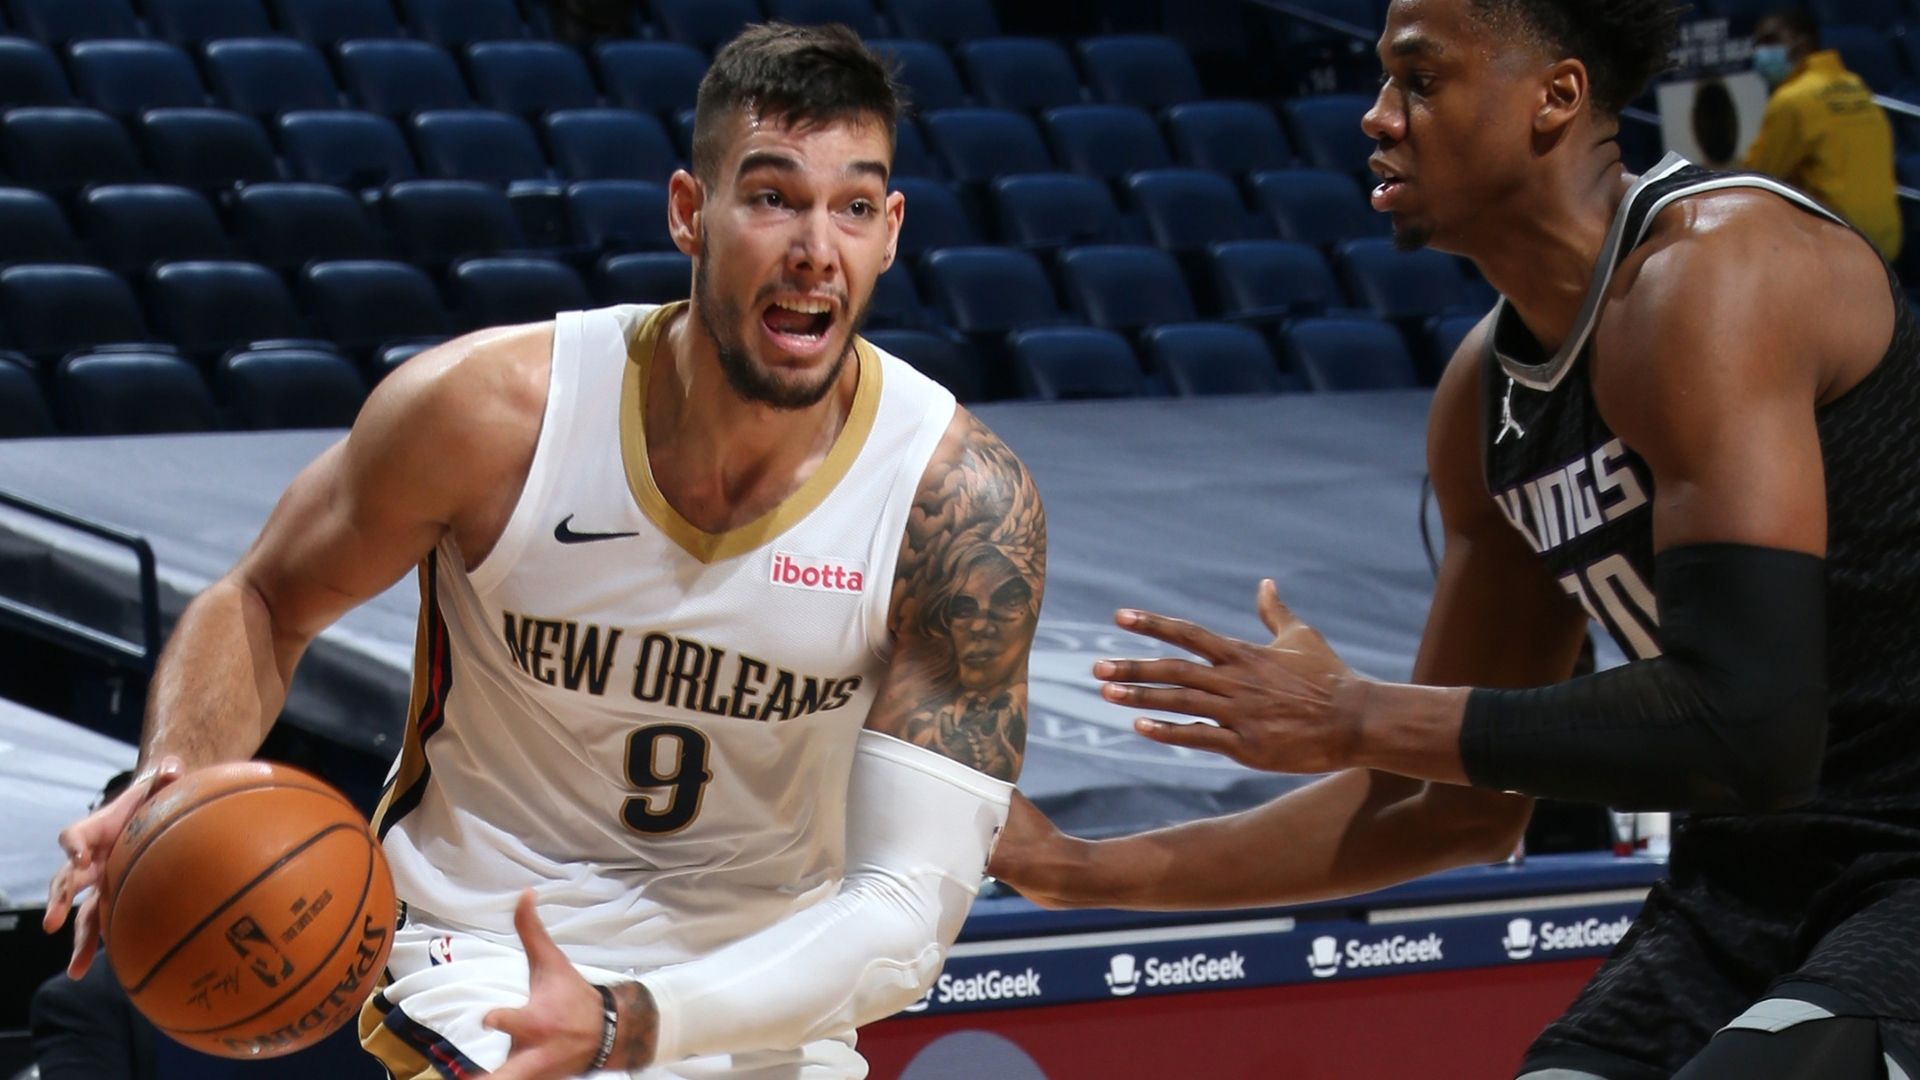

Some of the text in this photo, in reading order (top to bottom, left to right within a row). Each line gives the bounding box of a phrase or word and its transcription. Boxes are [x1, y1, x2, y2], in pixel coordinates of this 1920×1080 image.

[1493, 436, 1648, 553] KINGS
[771, 554, 864, 592] ibotta
[502, 609, 863, 722] NEW ORLEANS
[618, 722, 714, 836] 9
[1145, 951, 1246, 987] SeatGeek
[1345, 933, 1444, 968] SeatGeek
[937, 967, 1042, 1003] SeatGeek
